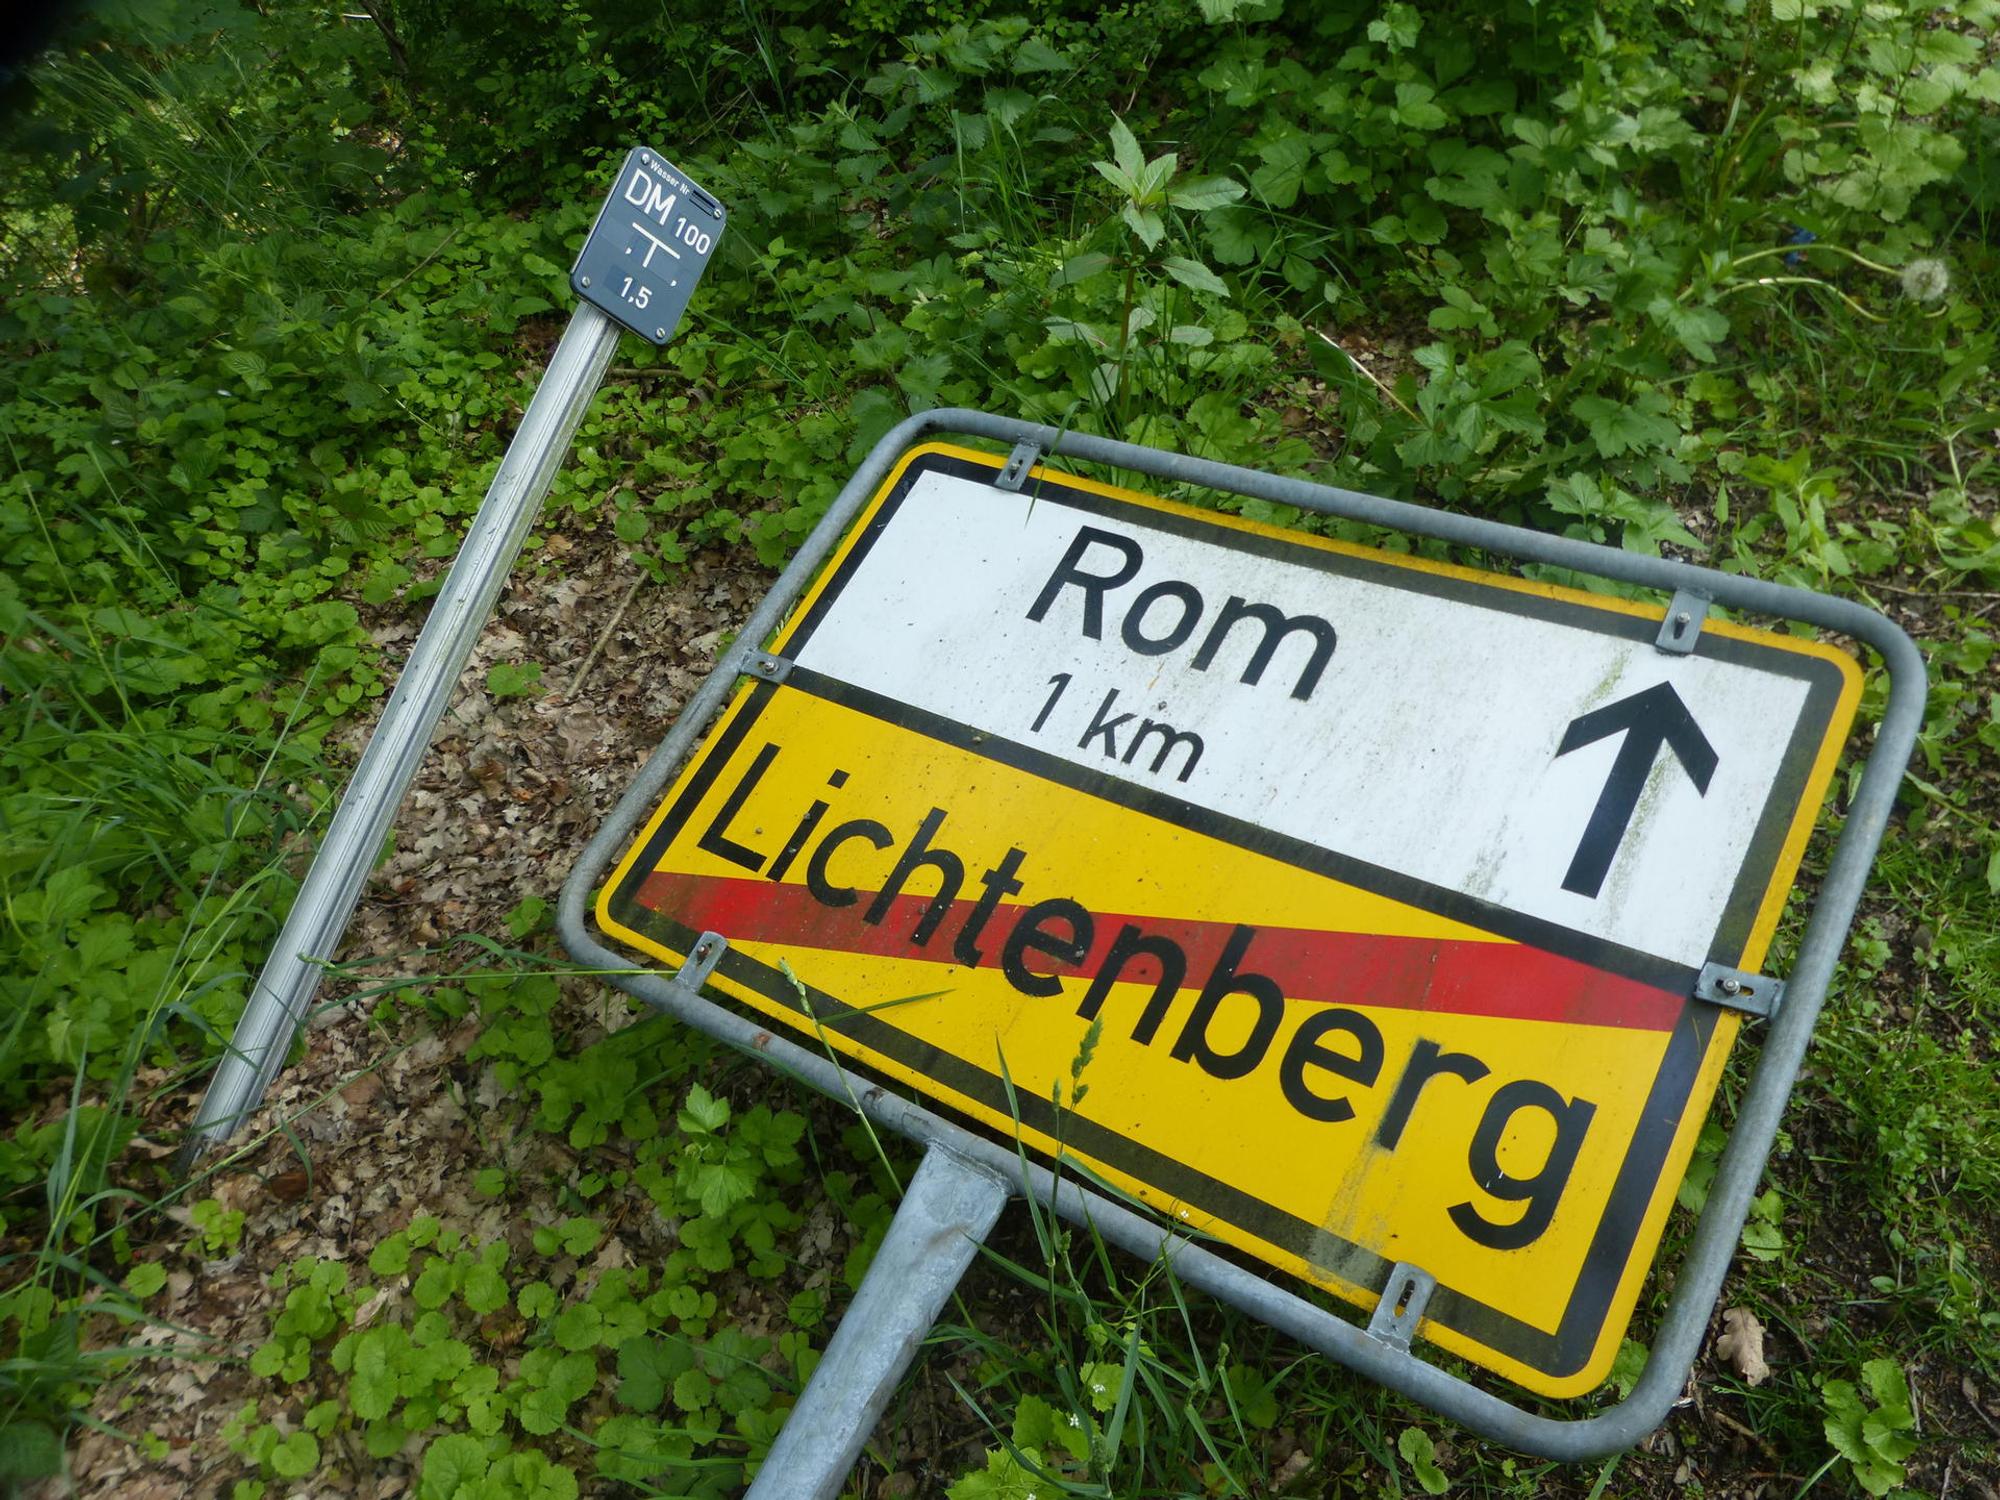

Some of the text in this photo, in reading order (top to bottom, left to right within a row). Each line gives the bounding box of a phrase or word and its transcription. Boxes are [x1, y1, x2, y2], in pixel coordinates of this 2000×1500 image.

[624, 168, 711, 255] DM 100
[650, 160, 679, 187] Wasser
[1025, 525, 1337, 702] Rom
[1030, 672, 1205, 784] 1 km
[697, 742, 1597, 1251] Lichtenberg
